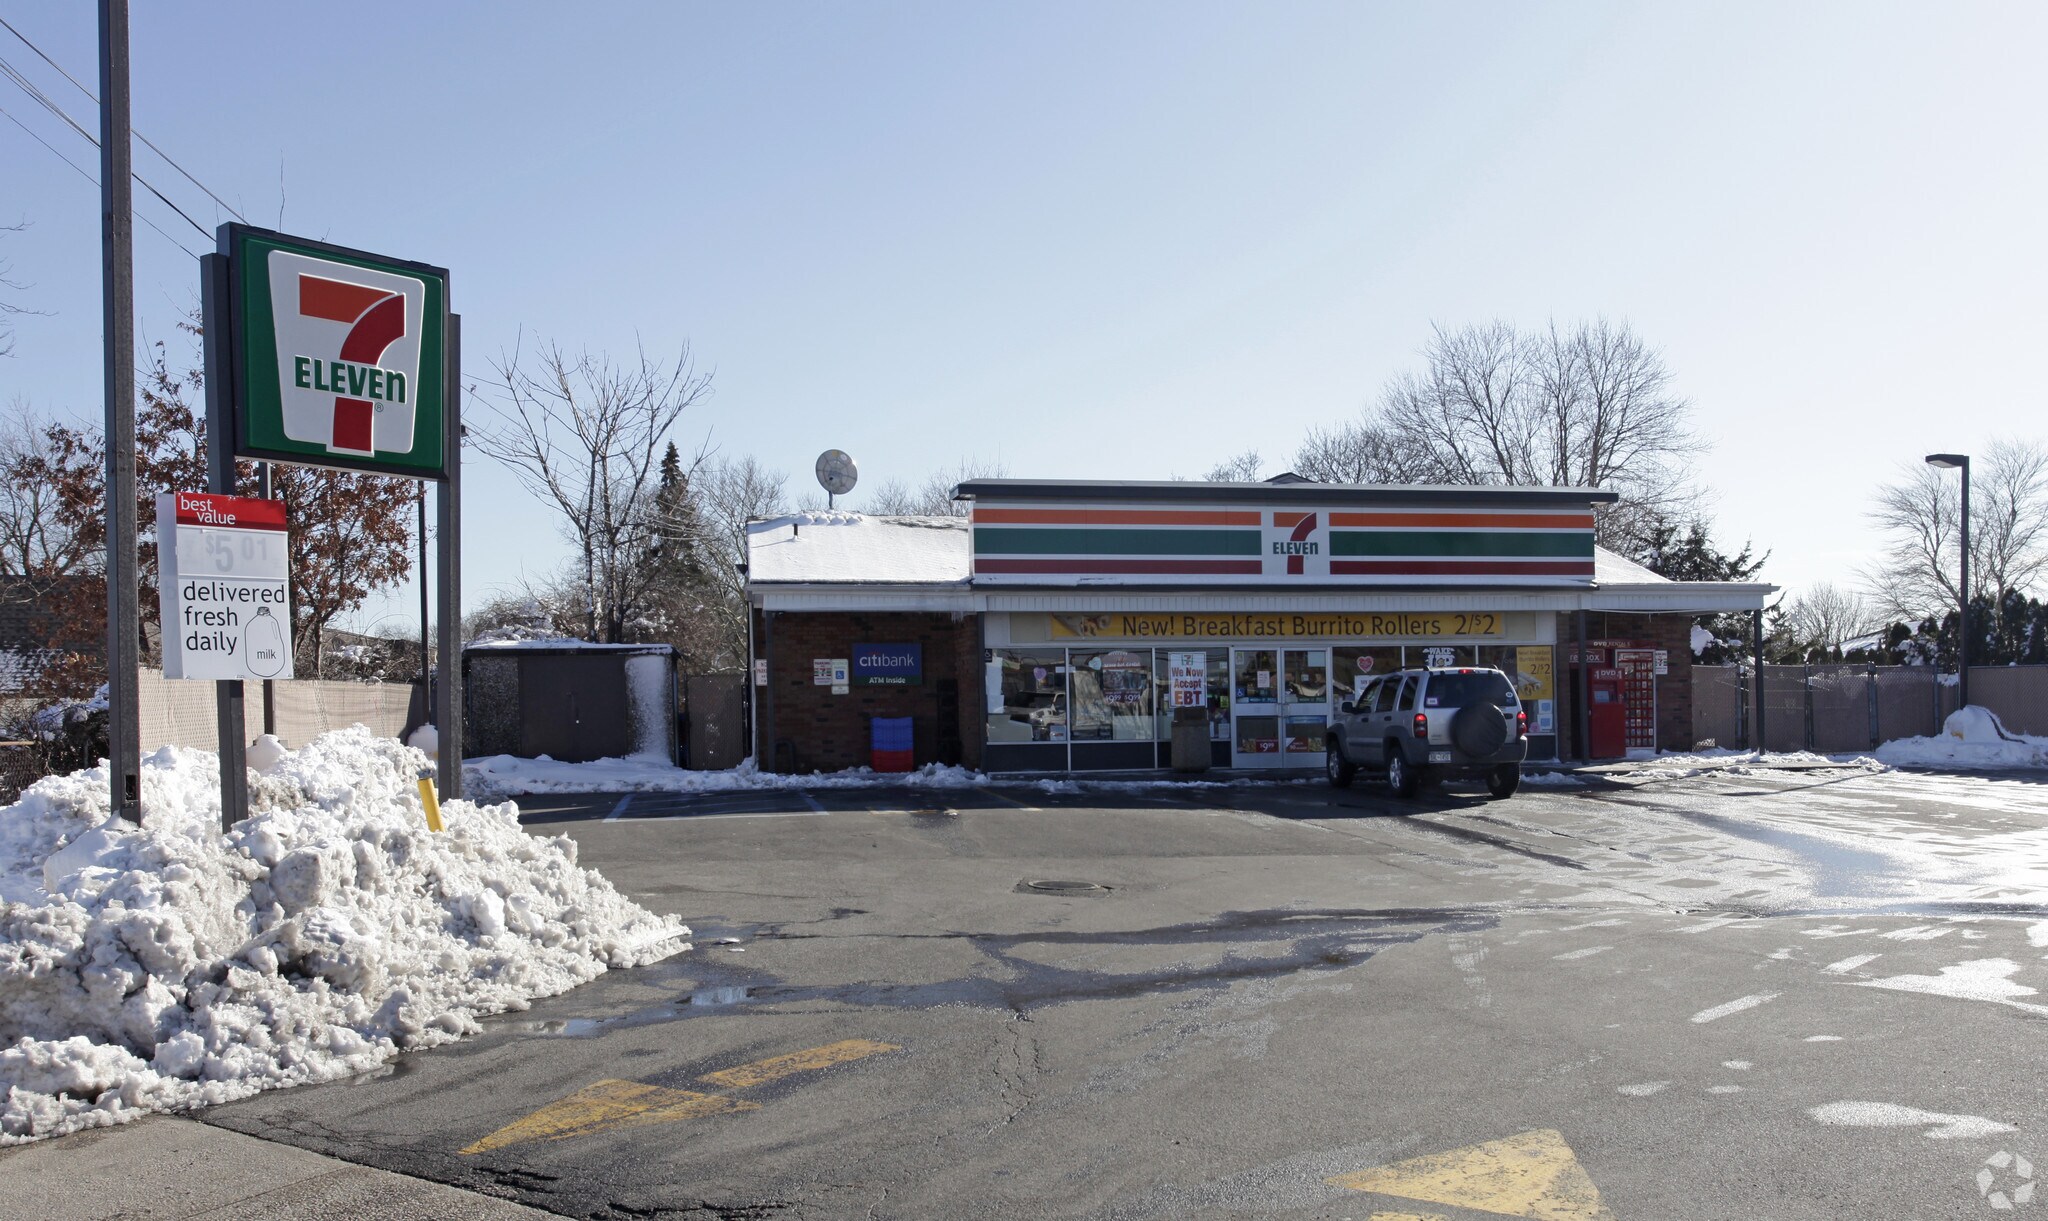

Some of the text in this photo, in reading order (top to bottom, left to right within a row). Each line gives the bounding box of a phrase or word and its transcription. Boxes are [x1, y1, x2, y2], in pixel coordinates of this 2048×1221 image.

[299, 273, 406, 452] 7
[180, 496, 213, 512] best
[196, 510, 236, 525] value
[1273, 512, 1317, 575] 7
[183, 581, 285, 604] delivered
[184, 606, 238, 626] fresh
[1122, 614, 1495, 636] New! Breakfast Burrito Rollers 2/$2
[186, 631, 238, 656] daily
[1429, 647, 1452, 655] WAKE
[256, 649, 277, 660] milk
[859, 652, 915, 667] citibank
[1172, 667, 1204, 677] We Now
[868, 676, 906, 684] ATM Inside
[1174, 678, 1202, 690] Accept
[1175, 690, 1202, 705] EBT
